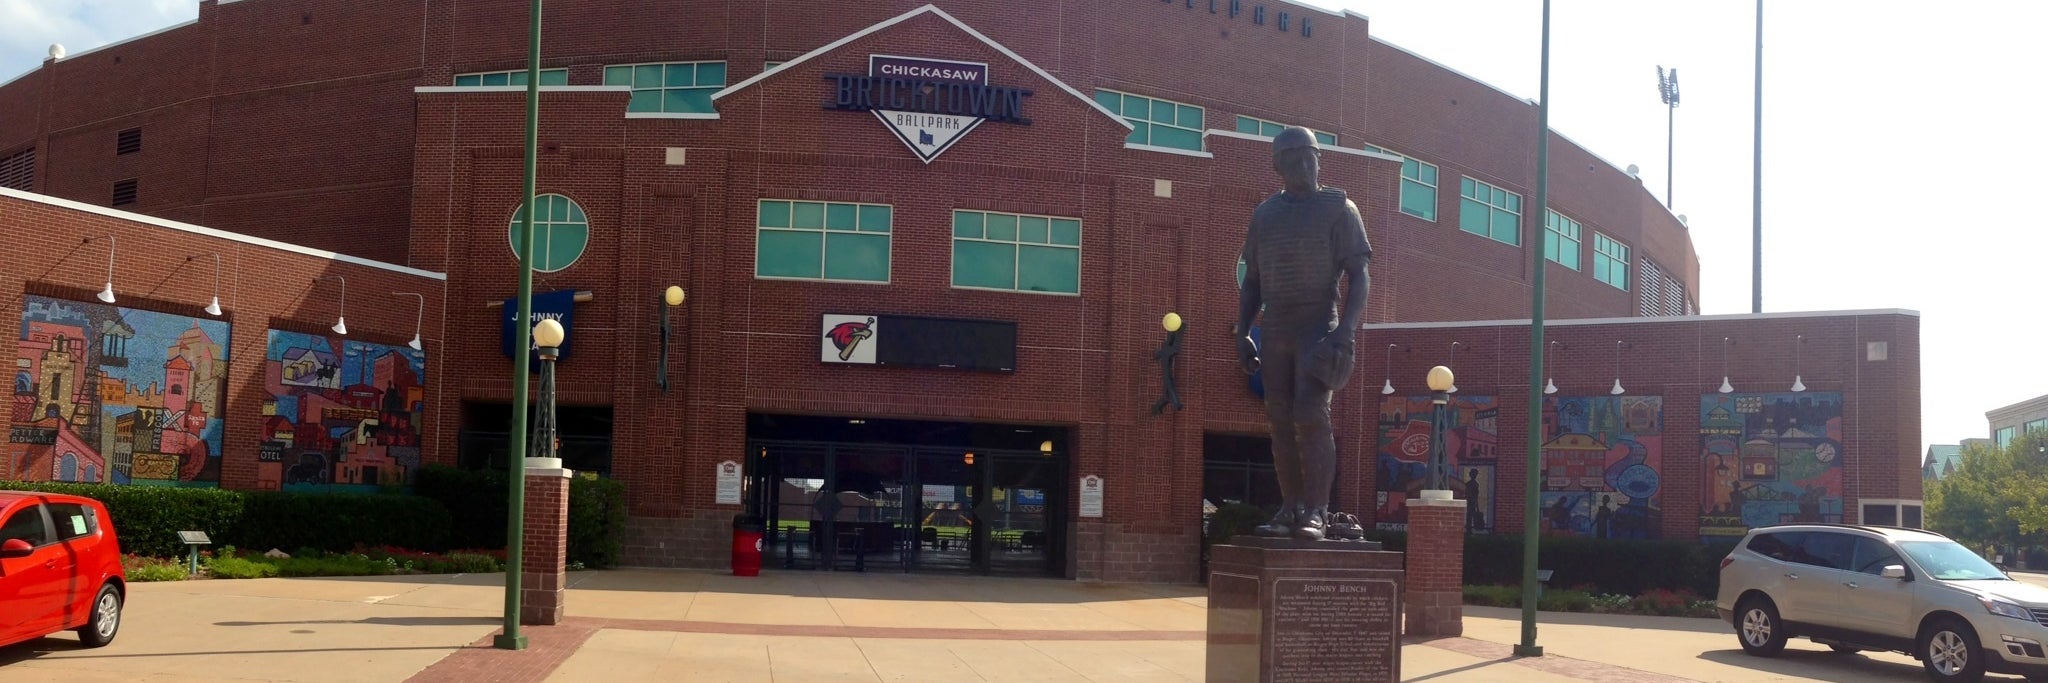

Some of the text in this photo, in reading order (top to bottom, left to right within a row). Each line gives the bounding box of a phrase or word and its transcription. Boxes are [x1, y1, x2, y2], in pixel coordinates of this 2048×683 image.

[881, 64, 978, 80] CHICKASAW
[837, 75, 1023, 119] BRICKTOWN
[897, 114, 960, 130] BALLPARK
[511, 311, 564, 322] JHNNY
[153, 415, 163, 450] FRISCO
[260, 450, 281, 460] OTEL
[1303, 584, 1367, 593] JOHNNY BENCH
